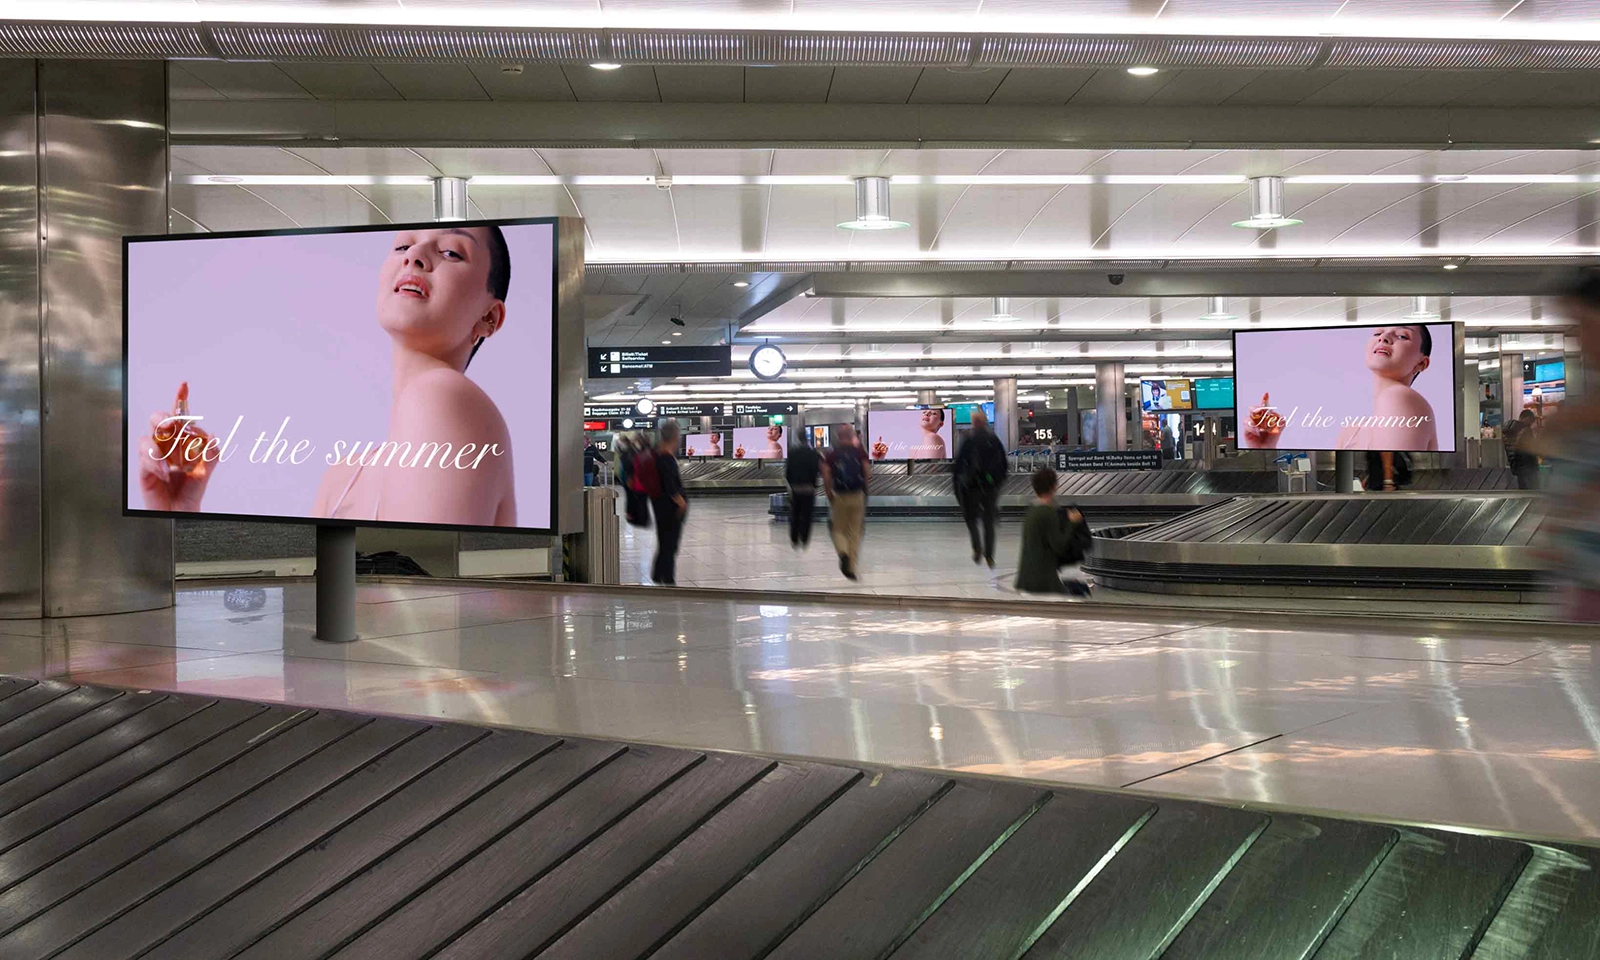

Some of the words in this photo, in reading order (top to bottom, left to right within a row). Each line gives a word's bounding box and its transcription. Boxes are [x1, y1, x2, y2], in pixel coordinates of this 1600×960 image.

[1247, 406, 1299, 428] Feel
[1301, 406, 1335, 428] the
[1340, 415, 1431, 428] summer
[148, 415, 244, 463] Feel
[249, 416, 316, 465] the
[325, 438, 504, 470] summer
[1034, 429, 1047, 440] 15
